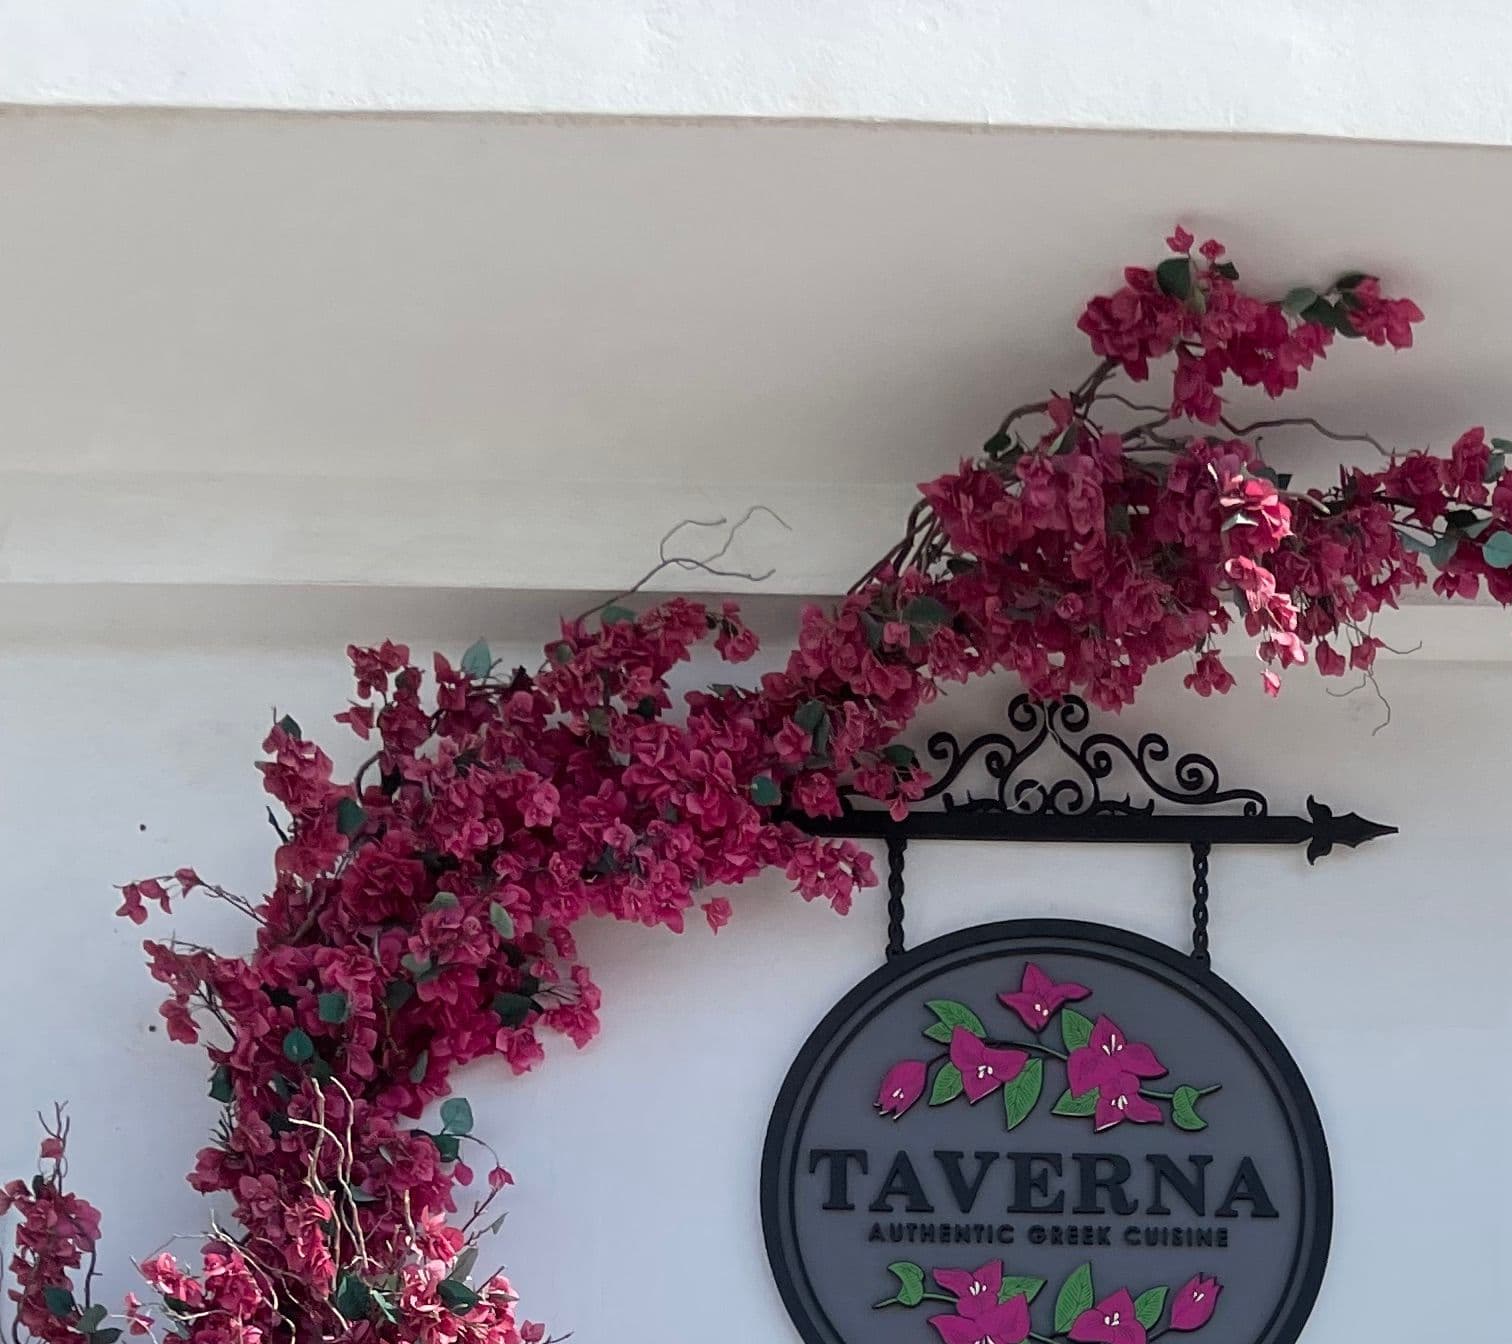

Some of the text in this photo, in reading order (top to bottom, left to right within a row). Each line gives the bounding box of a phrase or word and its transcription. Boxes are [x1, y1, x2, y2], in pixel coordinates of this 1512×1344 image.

[808, 1149, 1279, 1218] TAVERNA
[868, 1222, 1228, 1248] AUTHENTIC GREEK CUISINE
